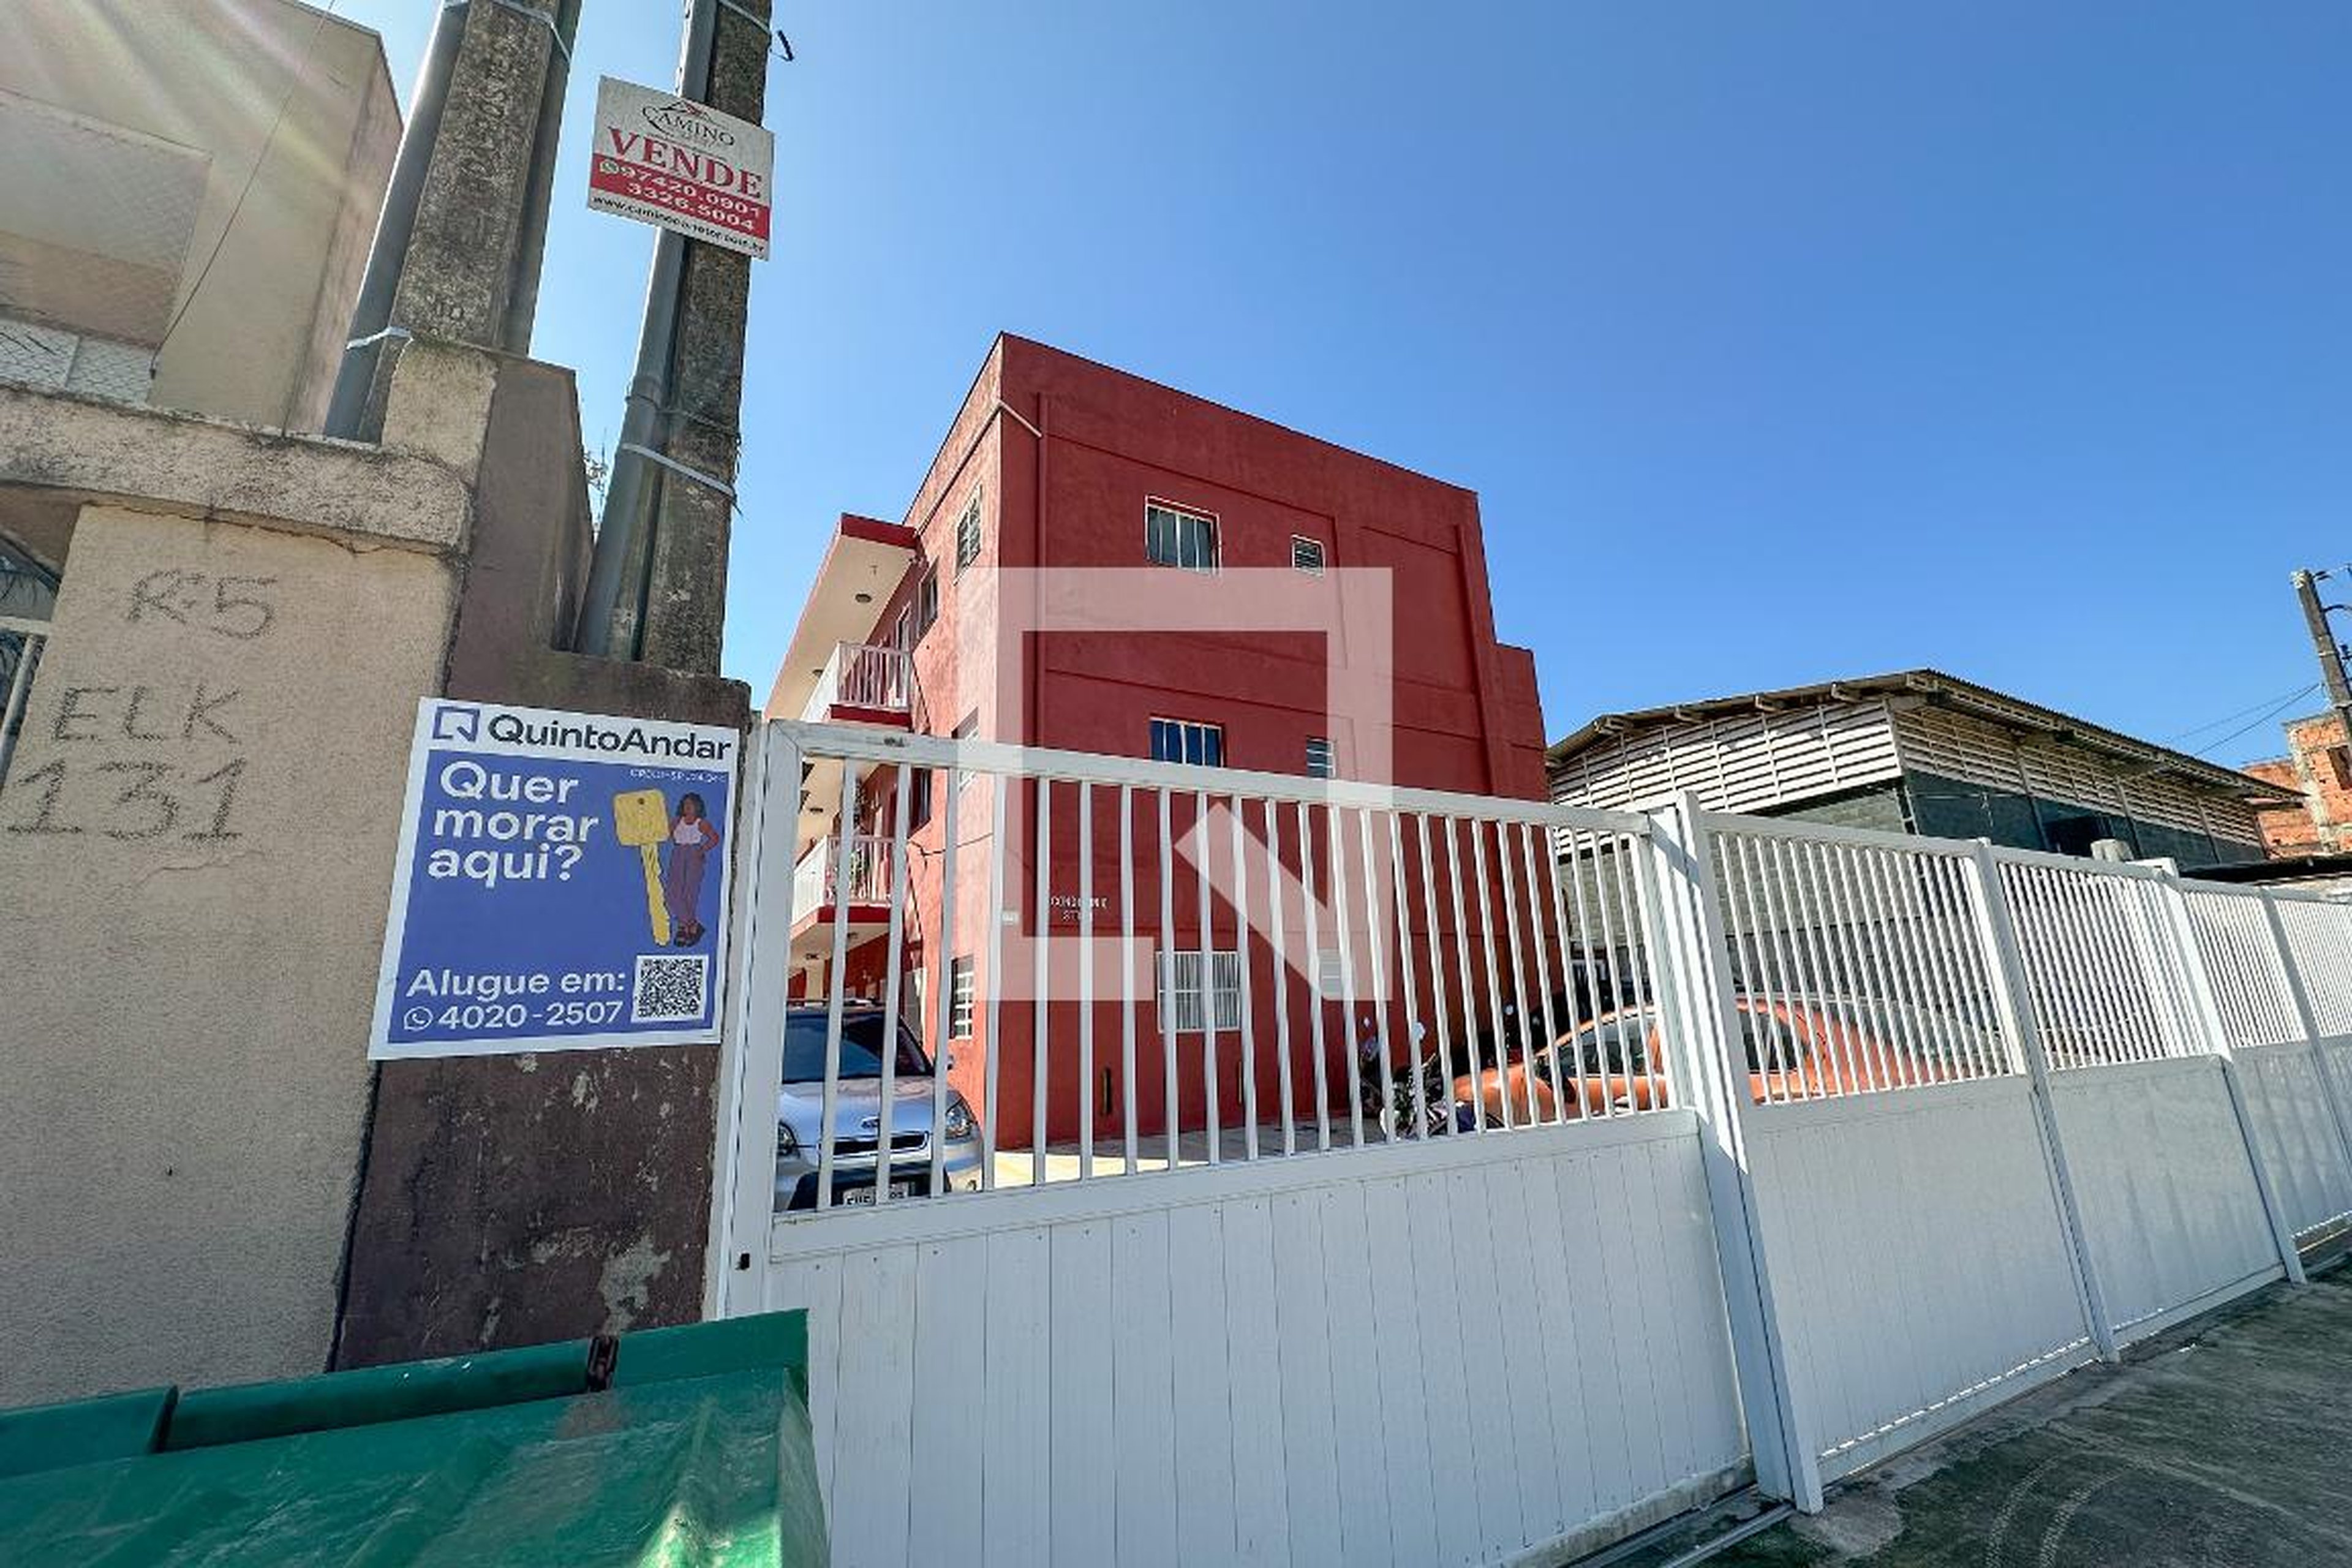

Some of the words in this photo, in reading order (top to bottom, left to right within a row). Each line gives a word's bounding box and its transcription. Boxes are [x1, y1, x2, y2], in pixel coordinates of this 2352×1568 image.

[643, 106, 734, 146] CAMINO
[607, 126, 761, 198] VENDE
[489, 714, 732, 760] QuintoAndar
[7, 758, 245, 842] 131
[440, 761, 579, 802] Quer
[434, 809, 598, 842] morar
[428, 843, 582, 888] aqui?
[406, 968, 549, 1001] Alugue
[560, 972, 624, 992] em:
